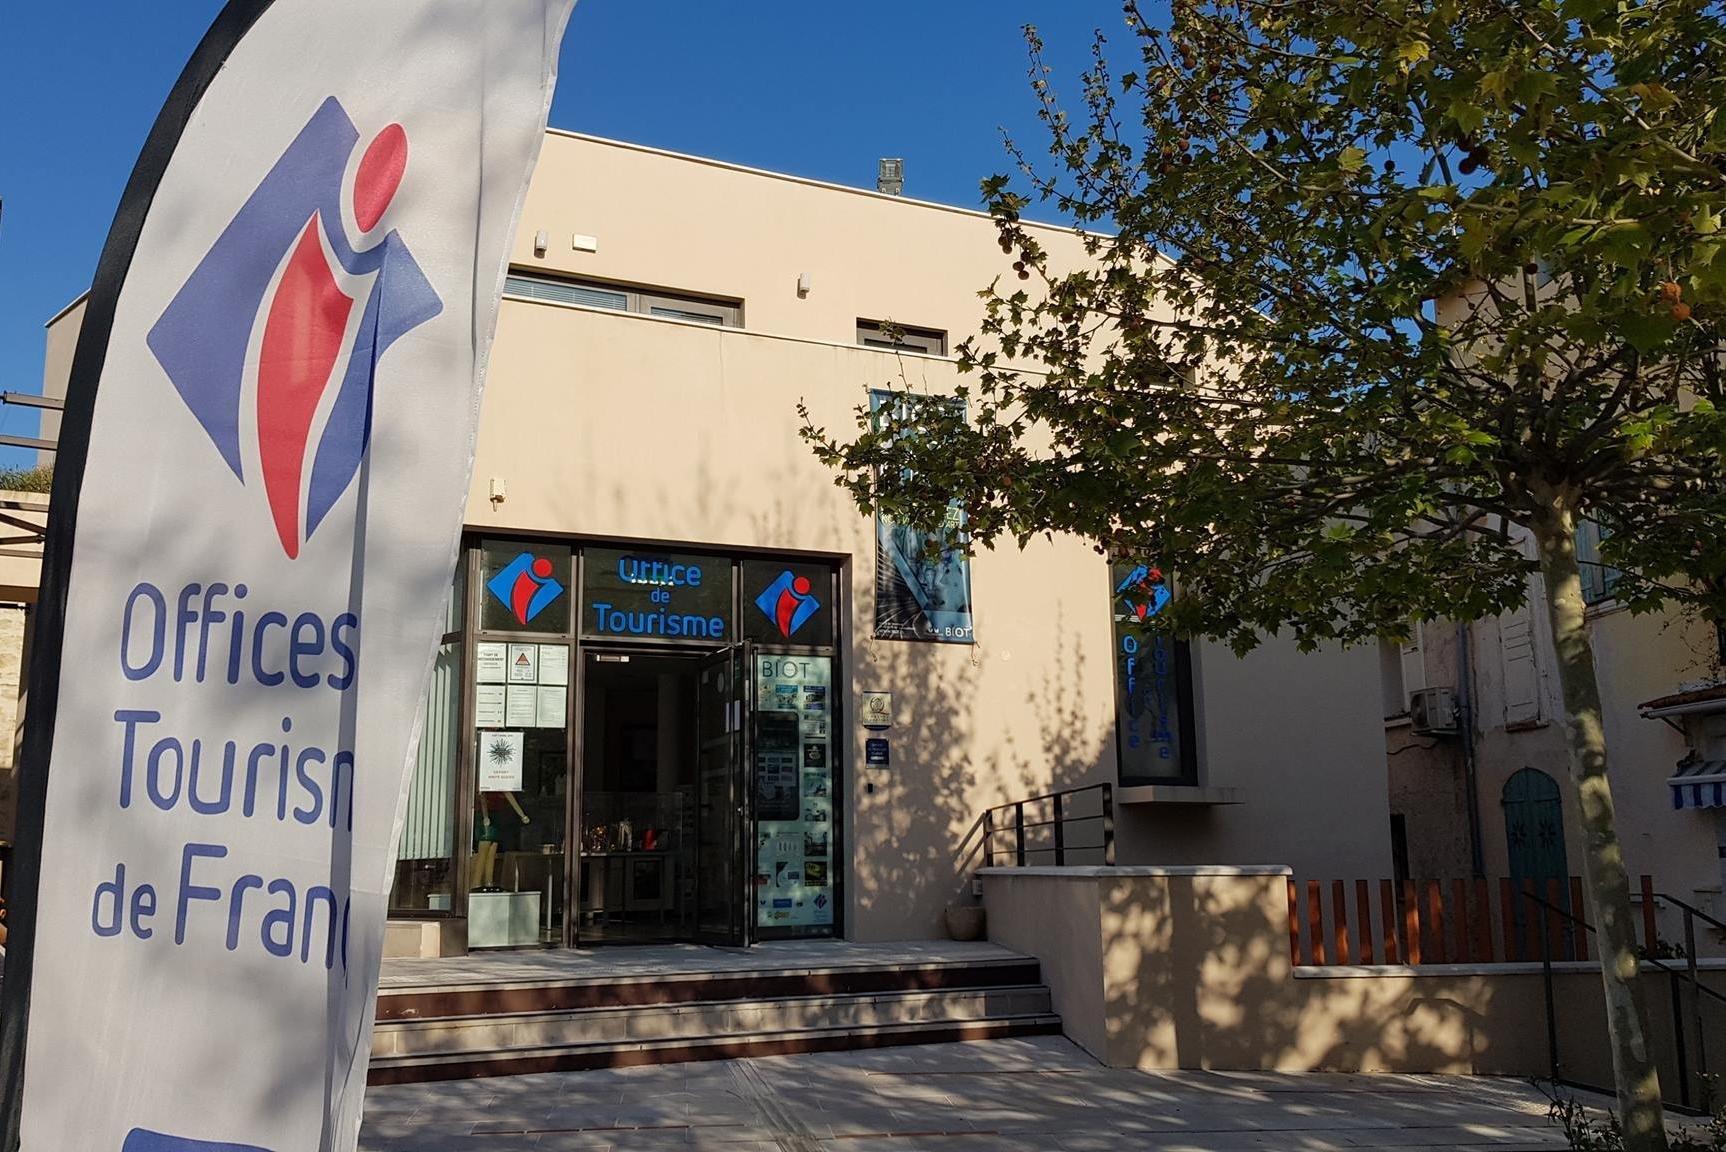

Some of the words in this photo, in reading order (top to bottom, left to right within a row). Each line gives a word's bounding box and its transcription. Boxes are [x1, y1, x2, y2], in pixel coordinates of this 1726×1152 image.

[649, 588, 671, 603] de
[592, 603, 725, 638] Tourisme
[944, 626, 970, 638] BIOT
[121, 582, 358, 691] Offices
[762, 661, 811, 679] BIOT
[91, 863, 156, 940] de
[174, 842, 350, 978] Fran
